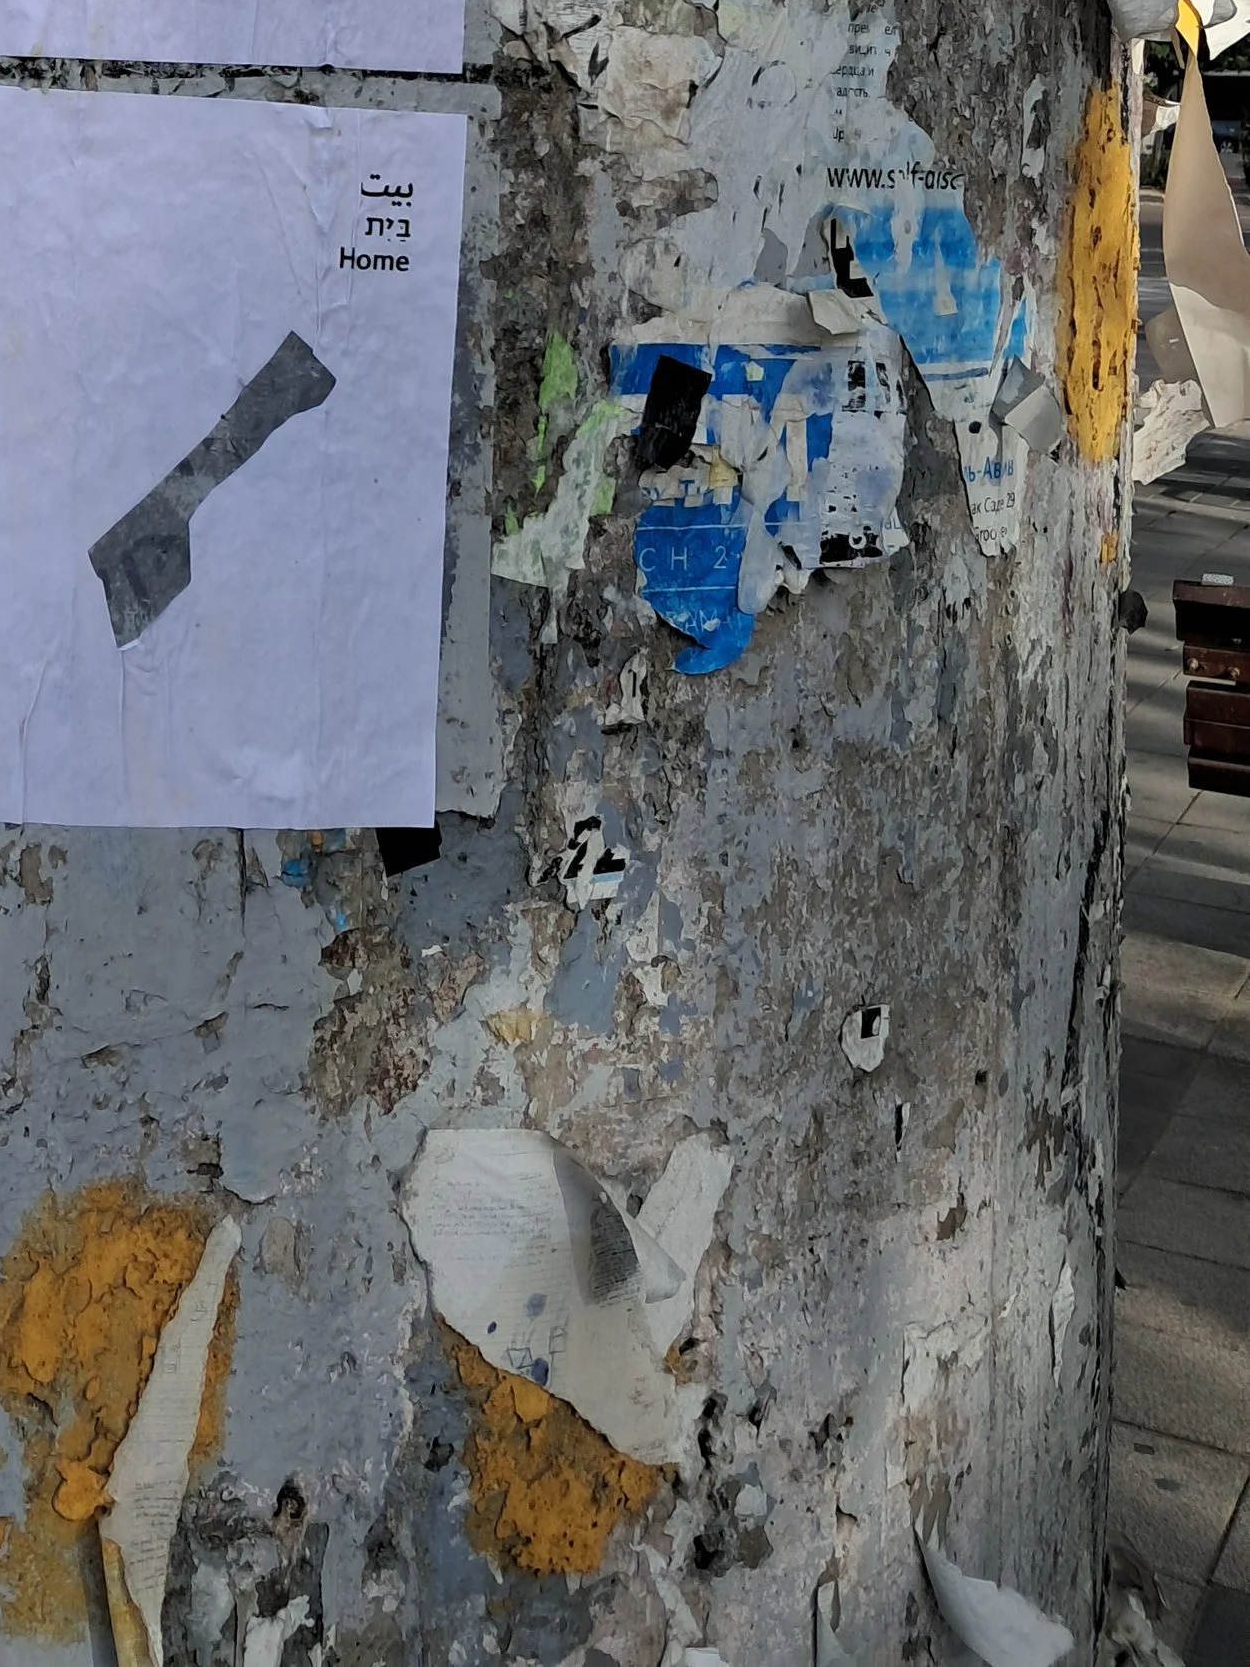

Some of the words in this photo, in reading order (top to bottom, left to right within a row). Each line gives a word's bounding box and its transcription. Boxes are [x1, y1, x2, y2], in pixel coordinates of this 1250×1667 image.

[361, 173, 414, 207] بيت
[339, 246, 410, 272] Home
[1006, 491, 1016, 509] 29
